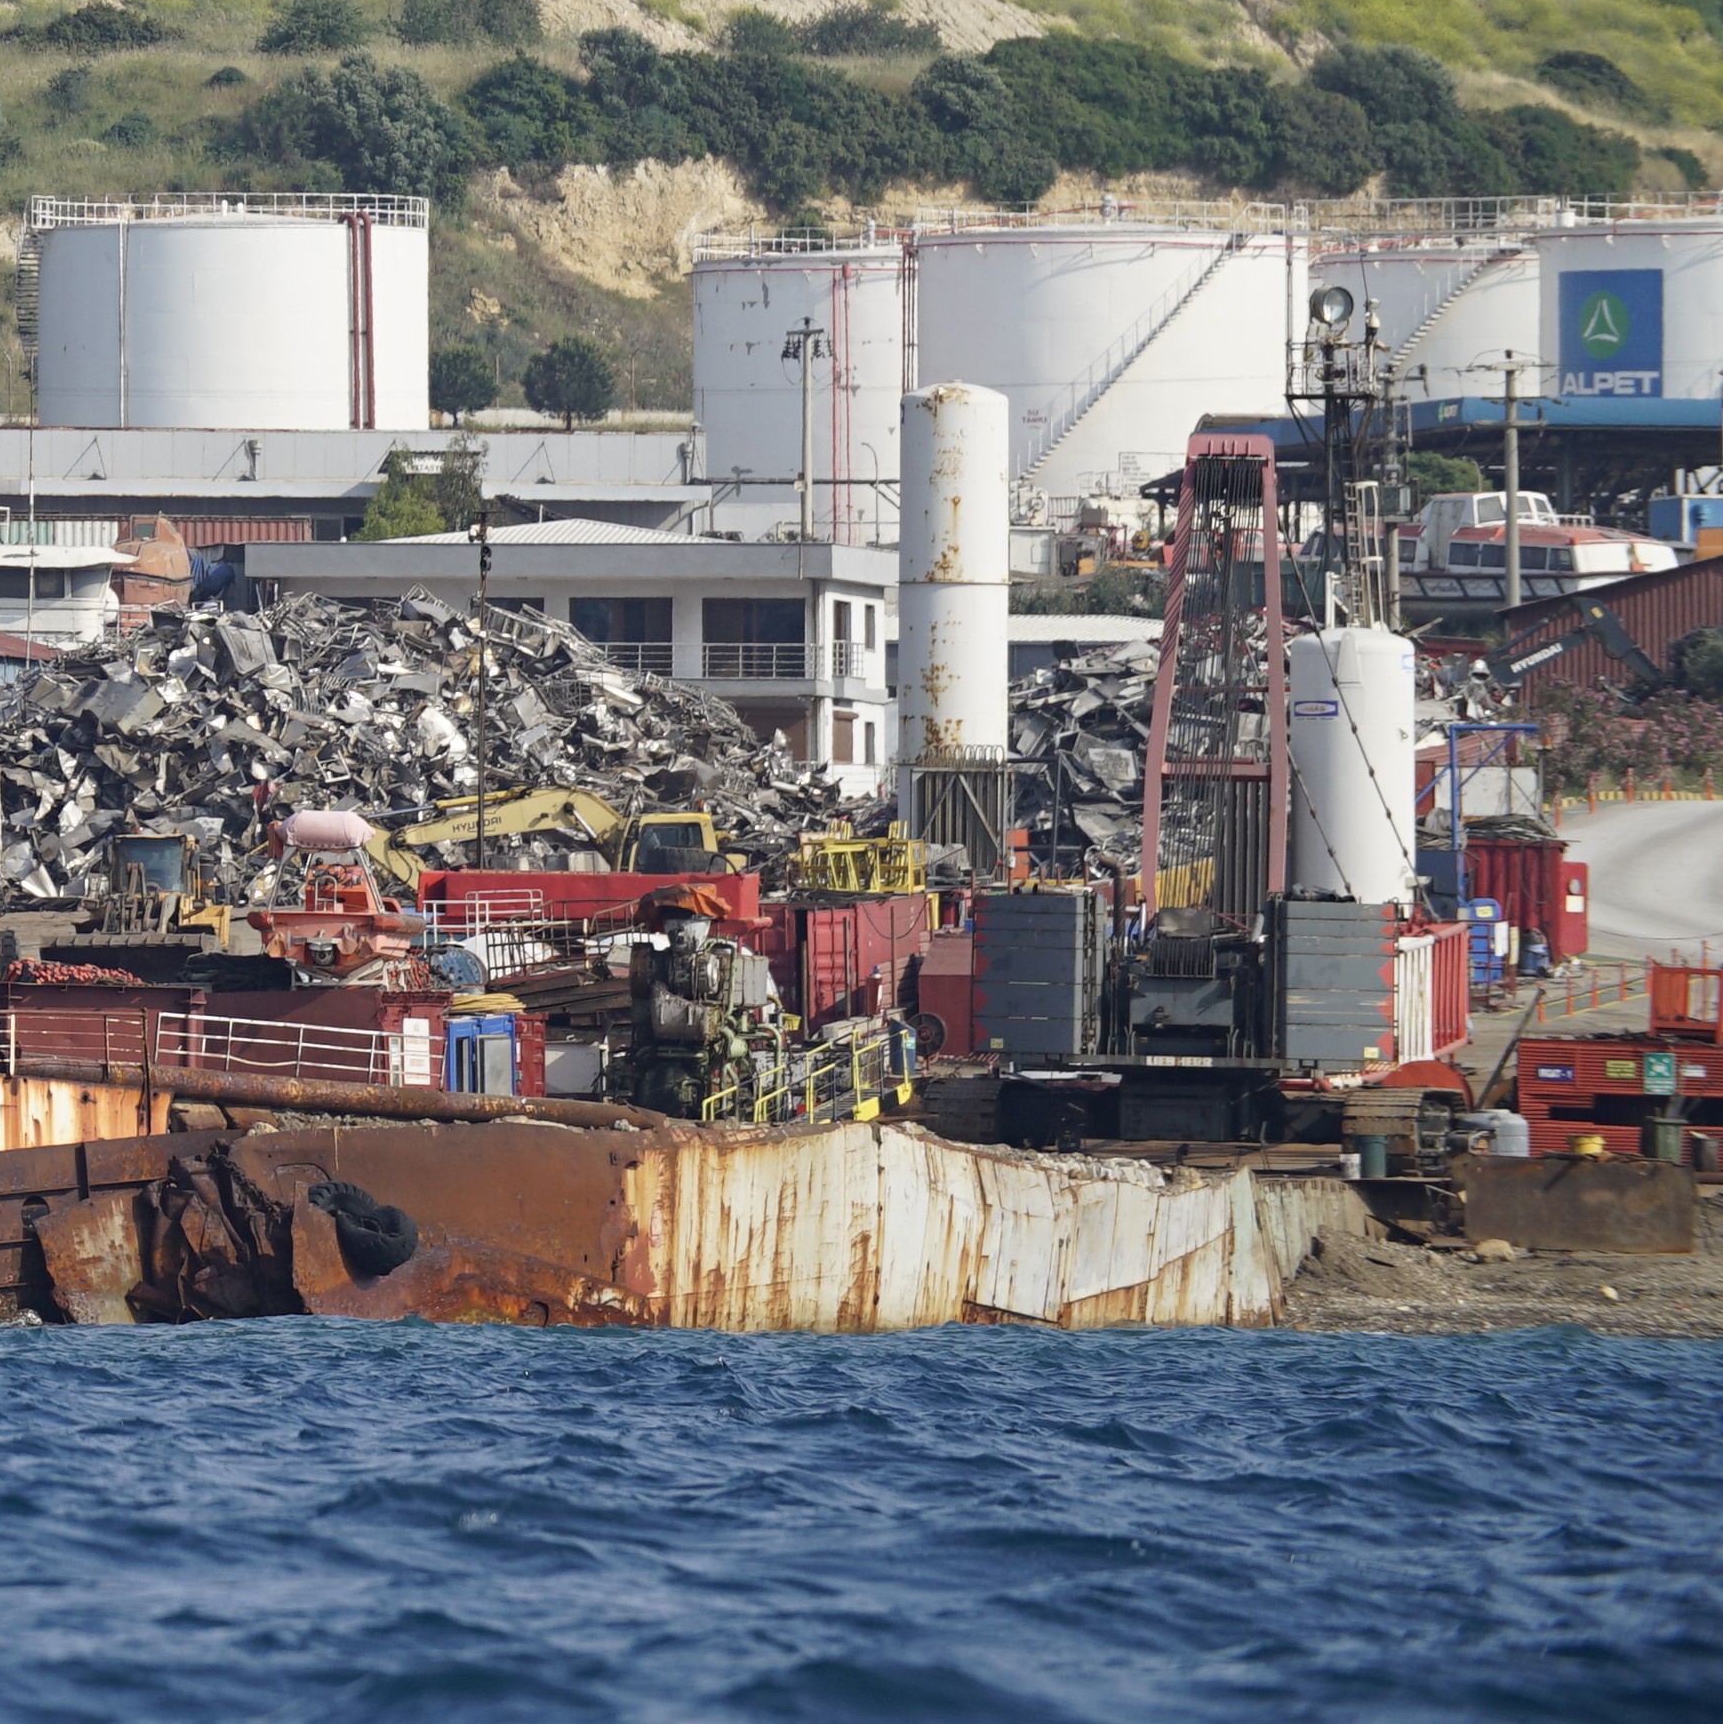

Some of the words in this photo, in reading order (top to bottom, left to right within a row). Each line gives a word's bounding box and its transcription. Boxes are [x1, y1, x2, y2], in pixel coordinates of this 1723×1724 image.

[1561, 371, 1659, 395] ALPET
[1510, 642, 1563, 674] HYUNDAI
[452, 816, 502, 833] HYUDAI
[1146, 1055, 1213, 1068] LIEBHERR
